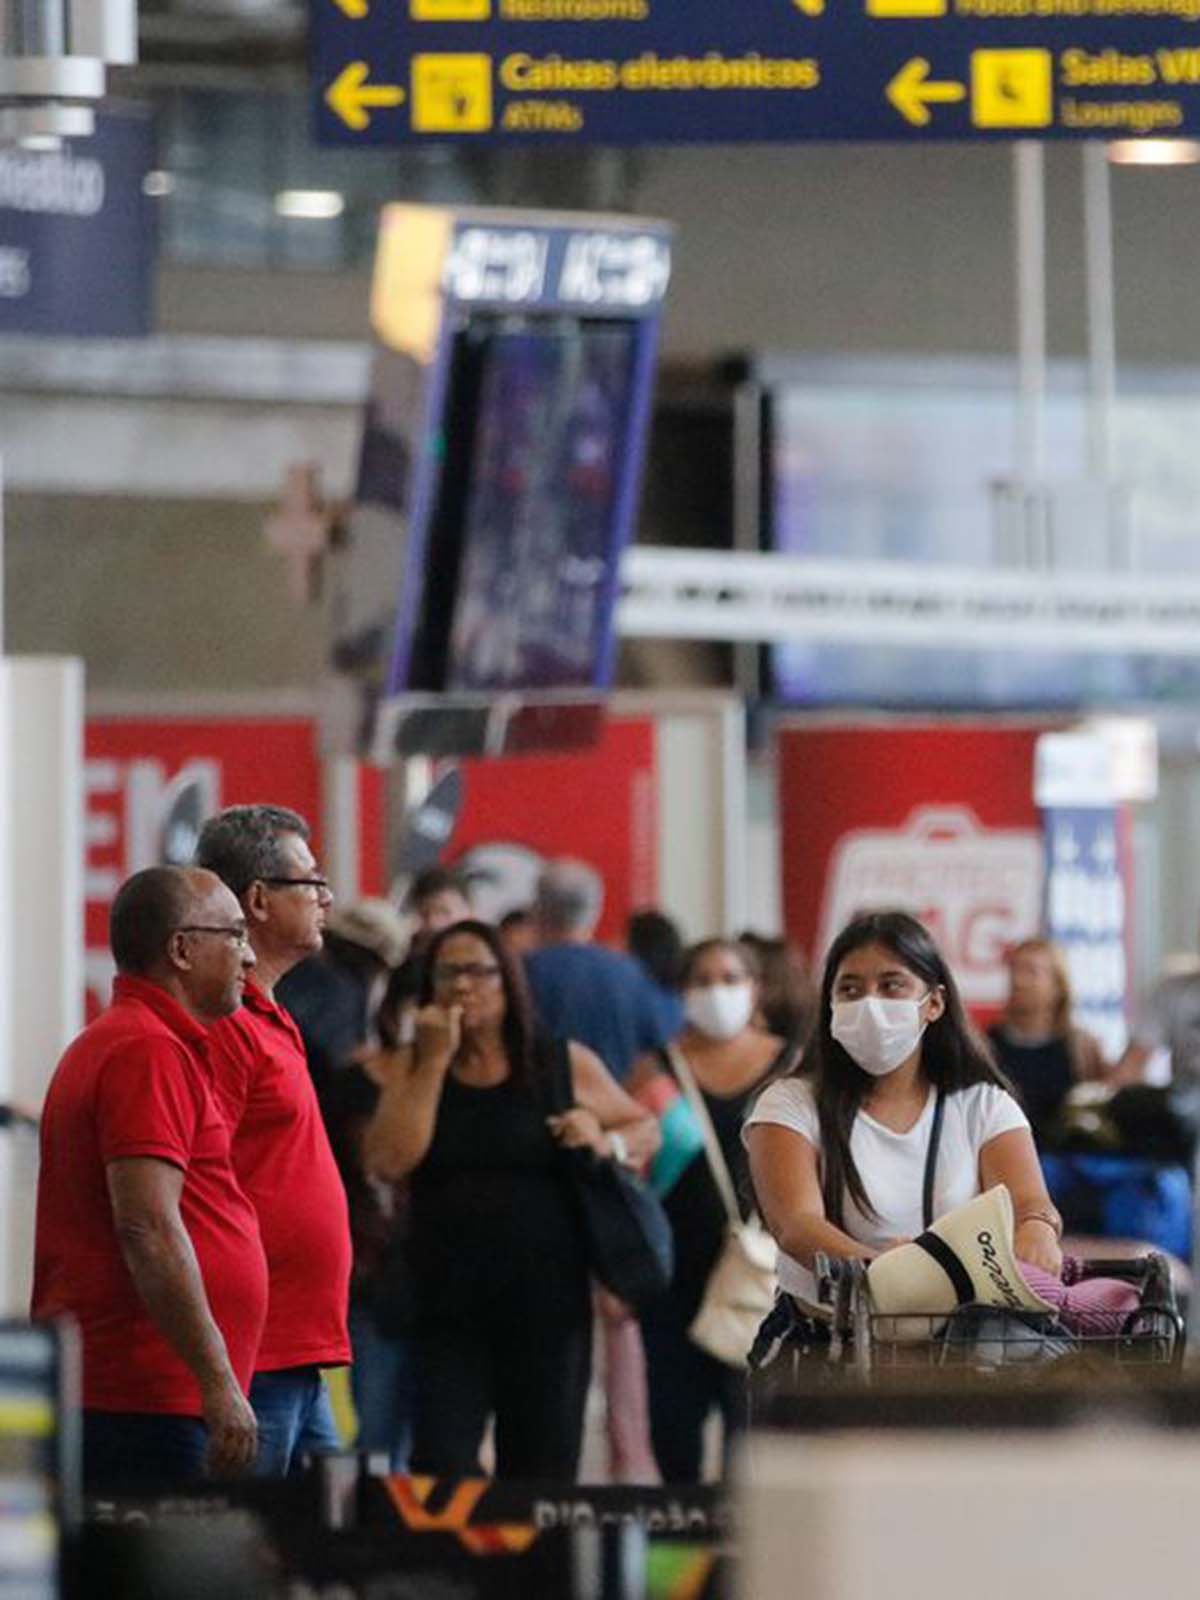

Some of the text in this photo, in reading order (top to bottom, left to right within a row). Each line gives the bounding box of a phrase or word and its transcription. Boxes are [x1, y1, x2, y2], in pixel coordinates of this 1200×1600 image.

[502, 52, 819, 89] Caixas eletrônicos
[1061, 48, 1154, 85] Salas
[504, 102, 582, 131] ATMs
[1061, 99, 1182, 132] Lounges
